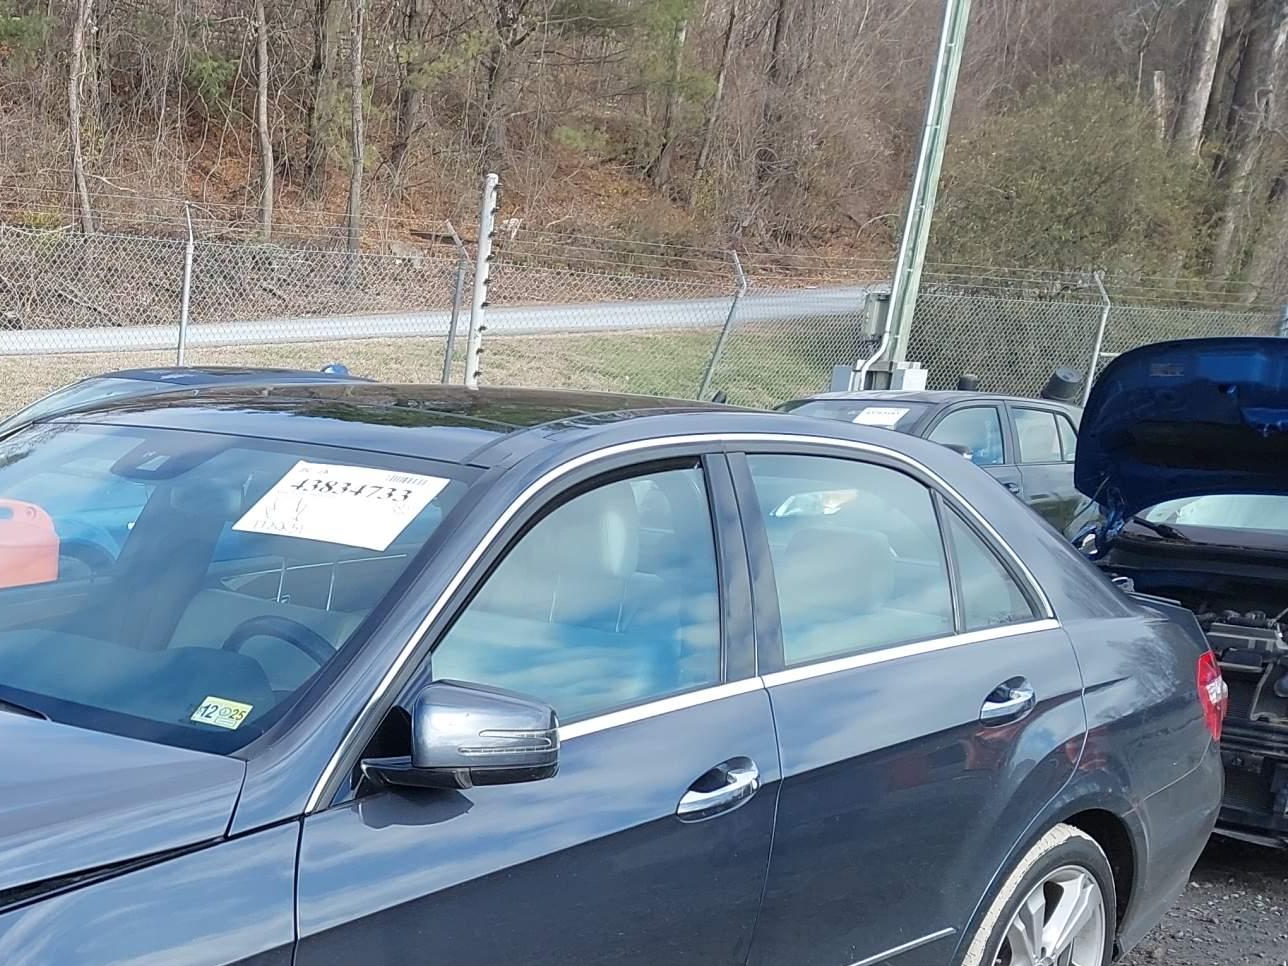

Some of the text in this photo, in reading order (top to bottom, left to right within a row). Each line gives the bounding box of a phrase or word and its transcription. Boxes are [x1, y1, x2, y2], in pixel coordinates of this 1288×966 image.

[291, 478, 413, 502] 43834733
[200, 703, 247, 721] 12 25
